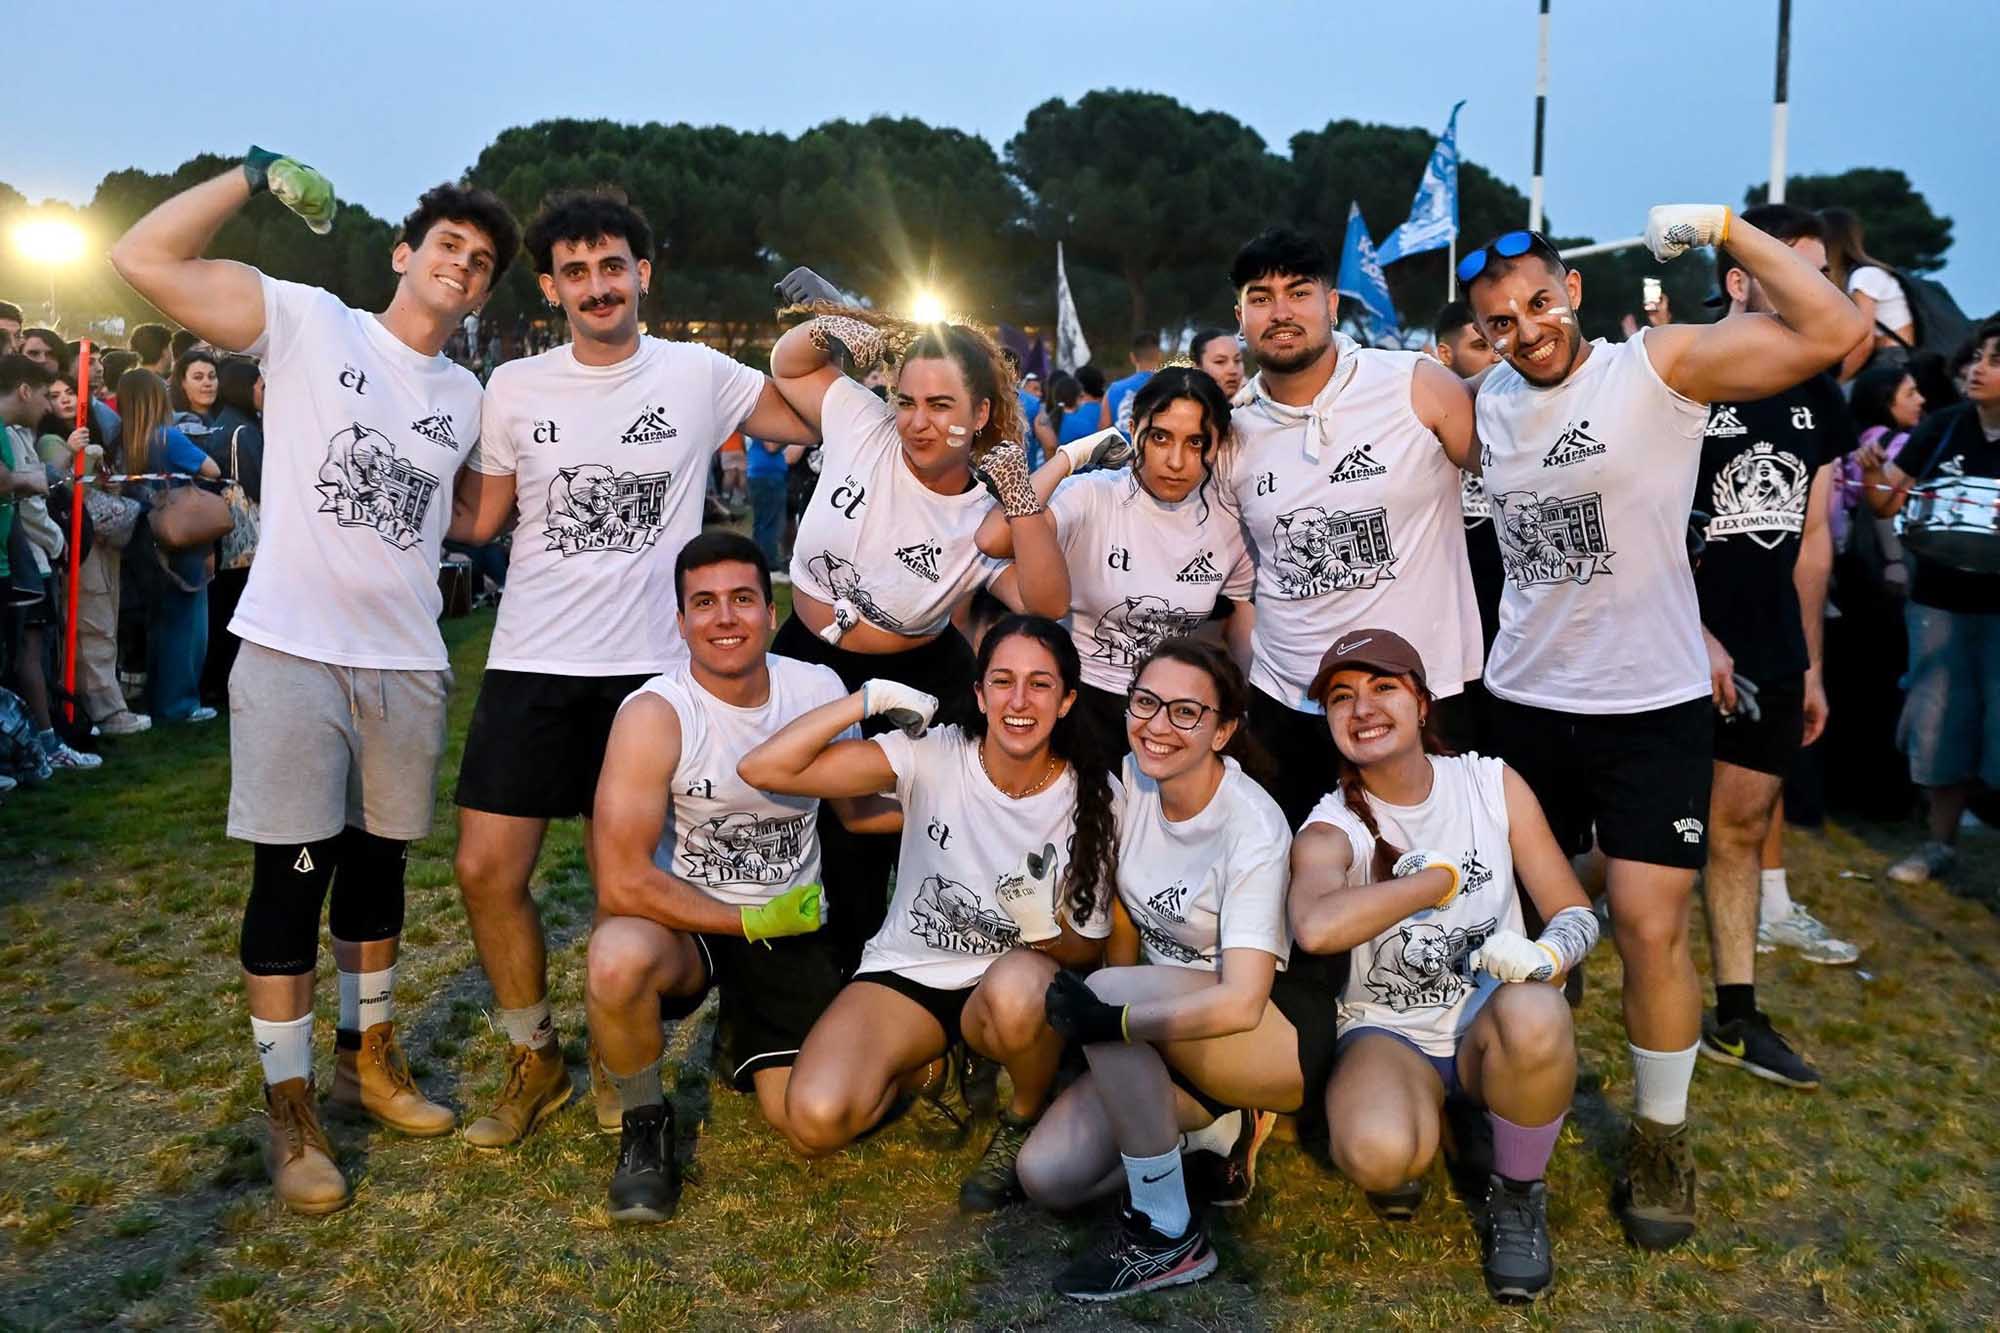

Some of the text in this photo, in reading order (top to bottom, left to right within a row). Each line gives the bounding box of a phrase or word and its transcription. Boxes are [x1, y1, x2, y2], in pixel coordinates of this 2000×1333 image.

[533, 420, 560, 443] ct
[621, 432, 649, 443] XXI
[650, 428, 677, 438] PALIO
[1542, 452, 1571, 468] XXI
[1572, 443, 1606, 457] PALIO
[1256, 471, 1278, 496] ct
[1328, 470, 1356, 484] XXI
[1357, 465, 1386, 475] PALIO
[830, 486, 866, 519] ct
[1716, 518, 1739, 531] LEX
[1741, 516, 1780, 528] OMNIA
[894, 547, 918, 569] XXI
[1108, 548, 1132, 572] ct
[1175, 573, 1200, 583] XXI
[1521, 561, 1583, 583] DISUM
[927, 823, 953, 851] ct
[1147, 896, 1165, 915] XXI
